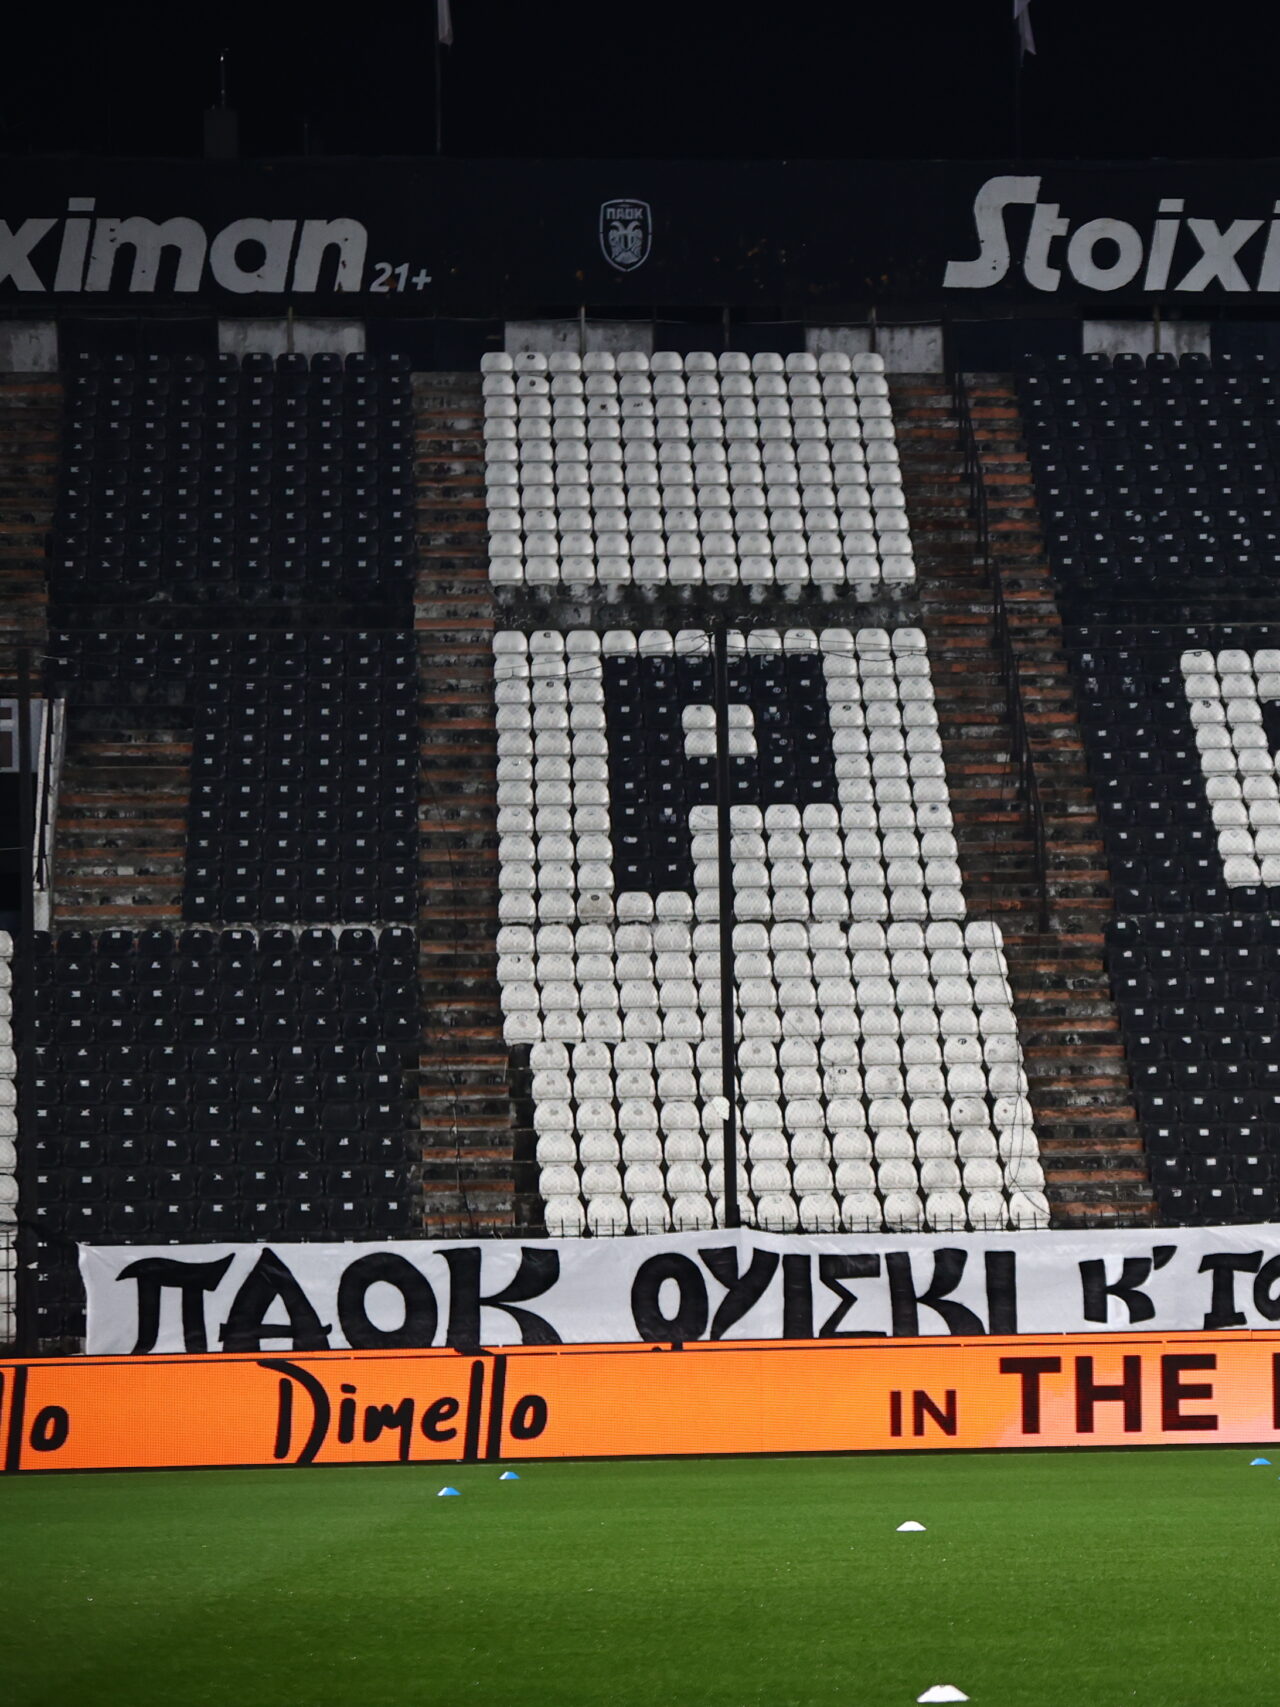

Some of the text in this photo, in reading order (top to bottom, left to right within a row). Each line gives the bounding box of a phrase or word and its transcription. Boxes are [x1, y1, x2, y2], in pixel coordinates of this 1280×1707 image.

[370, 262, 432, 292] 21+
[115, 1247, 562, 1356] ΠΑΟΚ
[631, 1246, 1017, 1343] ΟΥΙΣΚΙ
[256, 1354, 549, 1464] Dimello
[889, 1390, 957, 1437] IN
[1000, 1353, 1219, 1434] THE
